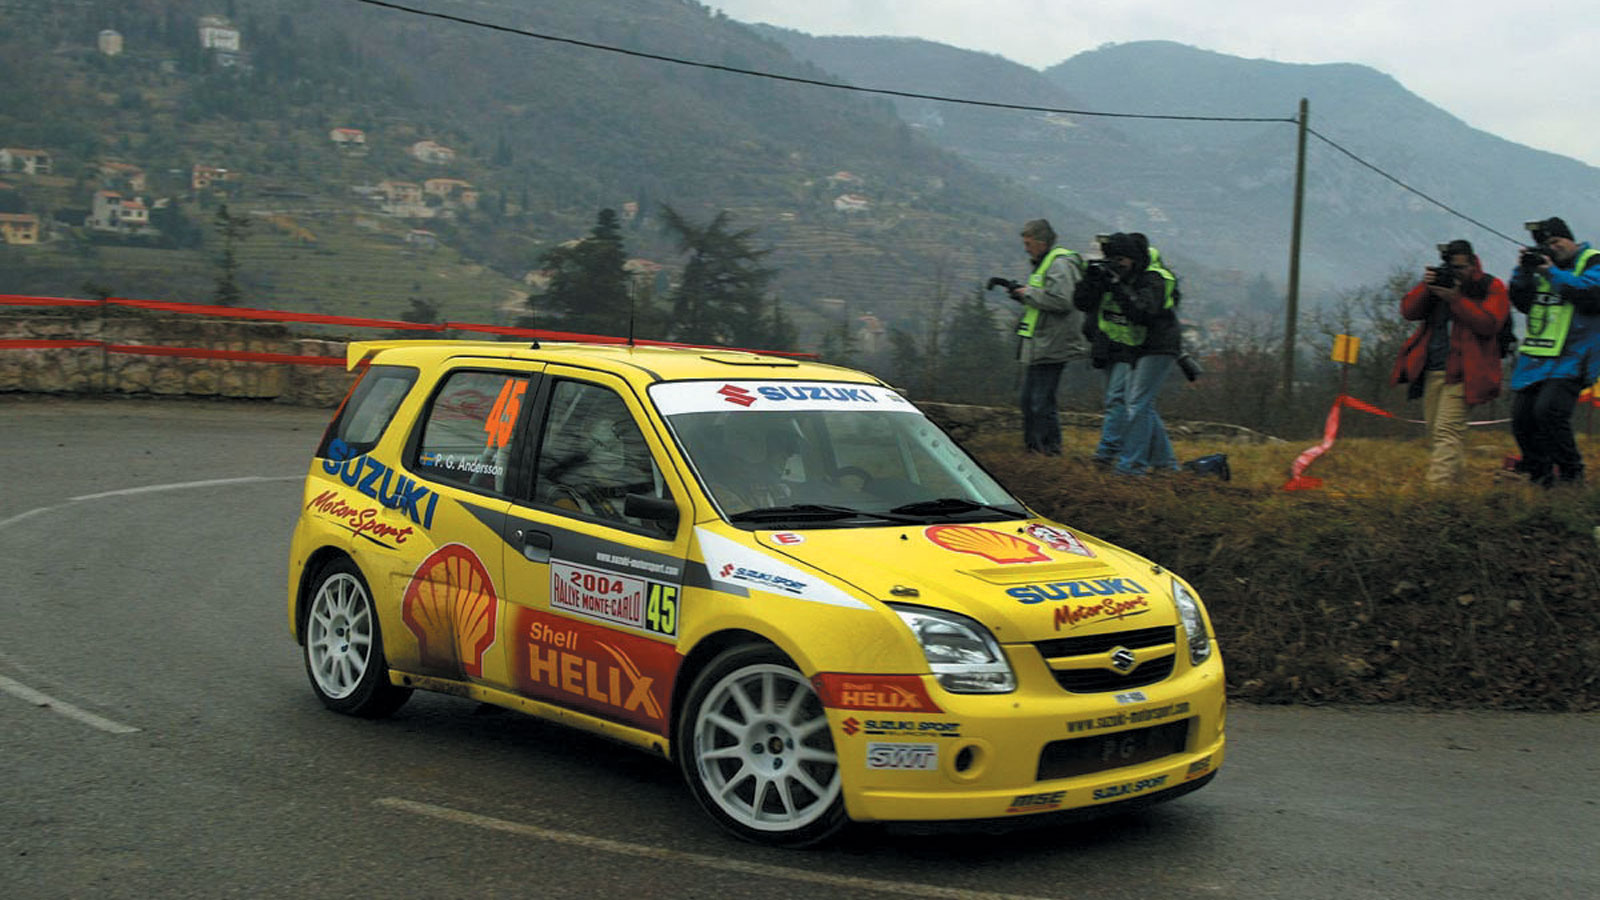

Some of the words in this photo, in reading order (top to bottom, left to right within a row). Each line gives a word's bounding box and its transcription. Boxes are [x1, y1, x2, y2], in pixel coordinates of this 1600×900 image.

[757, 386, 877, 403] SUZUKI
[484, 377, 528, 449] 45
[434, 454, 443, 467] P.
[446, 455, 455, 470] G.
[457, 456, 504, 476] Andersson
[322, 438, 440, 531] SUZUKI
[775, 533, 801, 544] E
[570, 571, 624, 595] 2004
[1005, 578, 1150, 604] SUZUKI
[553, 572, 580, 608] RALLYE
[582, 591, 641, 622] MONTE-CARLO
[647, 584, 676, 634] 45
[529, 622, 578, 651] Shell
[528, 641, 664, 720] HELIX
[841, 687, 923, 709] HELIX
[864, 720, 914, 731] SUZUKI
[917, 721, 961, 732] SPORT
[1093, 782, 1131, 800] SUZUKI
